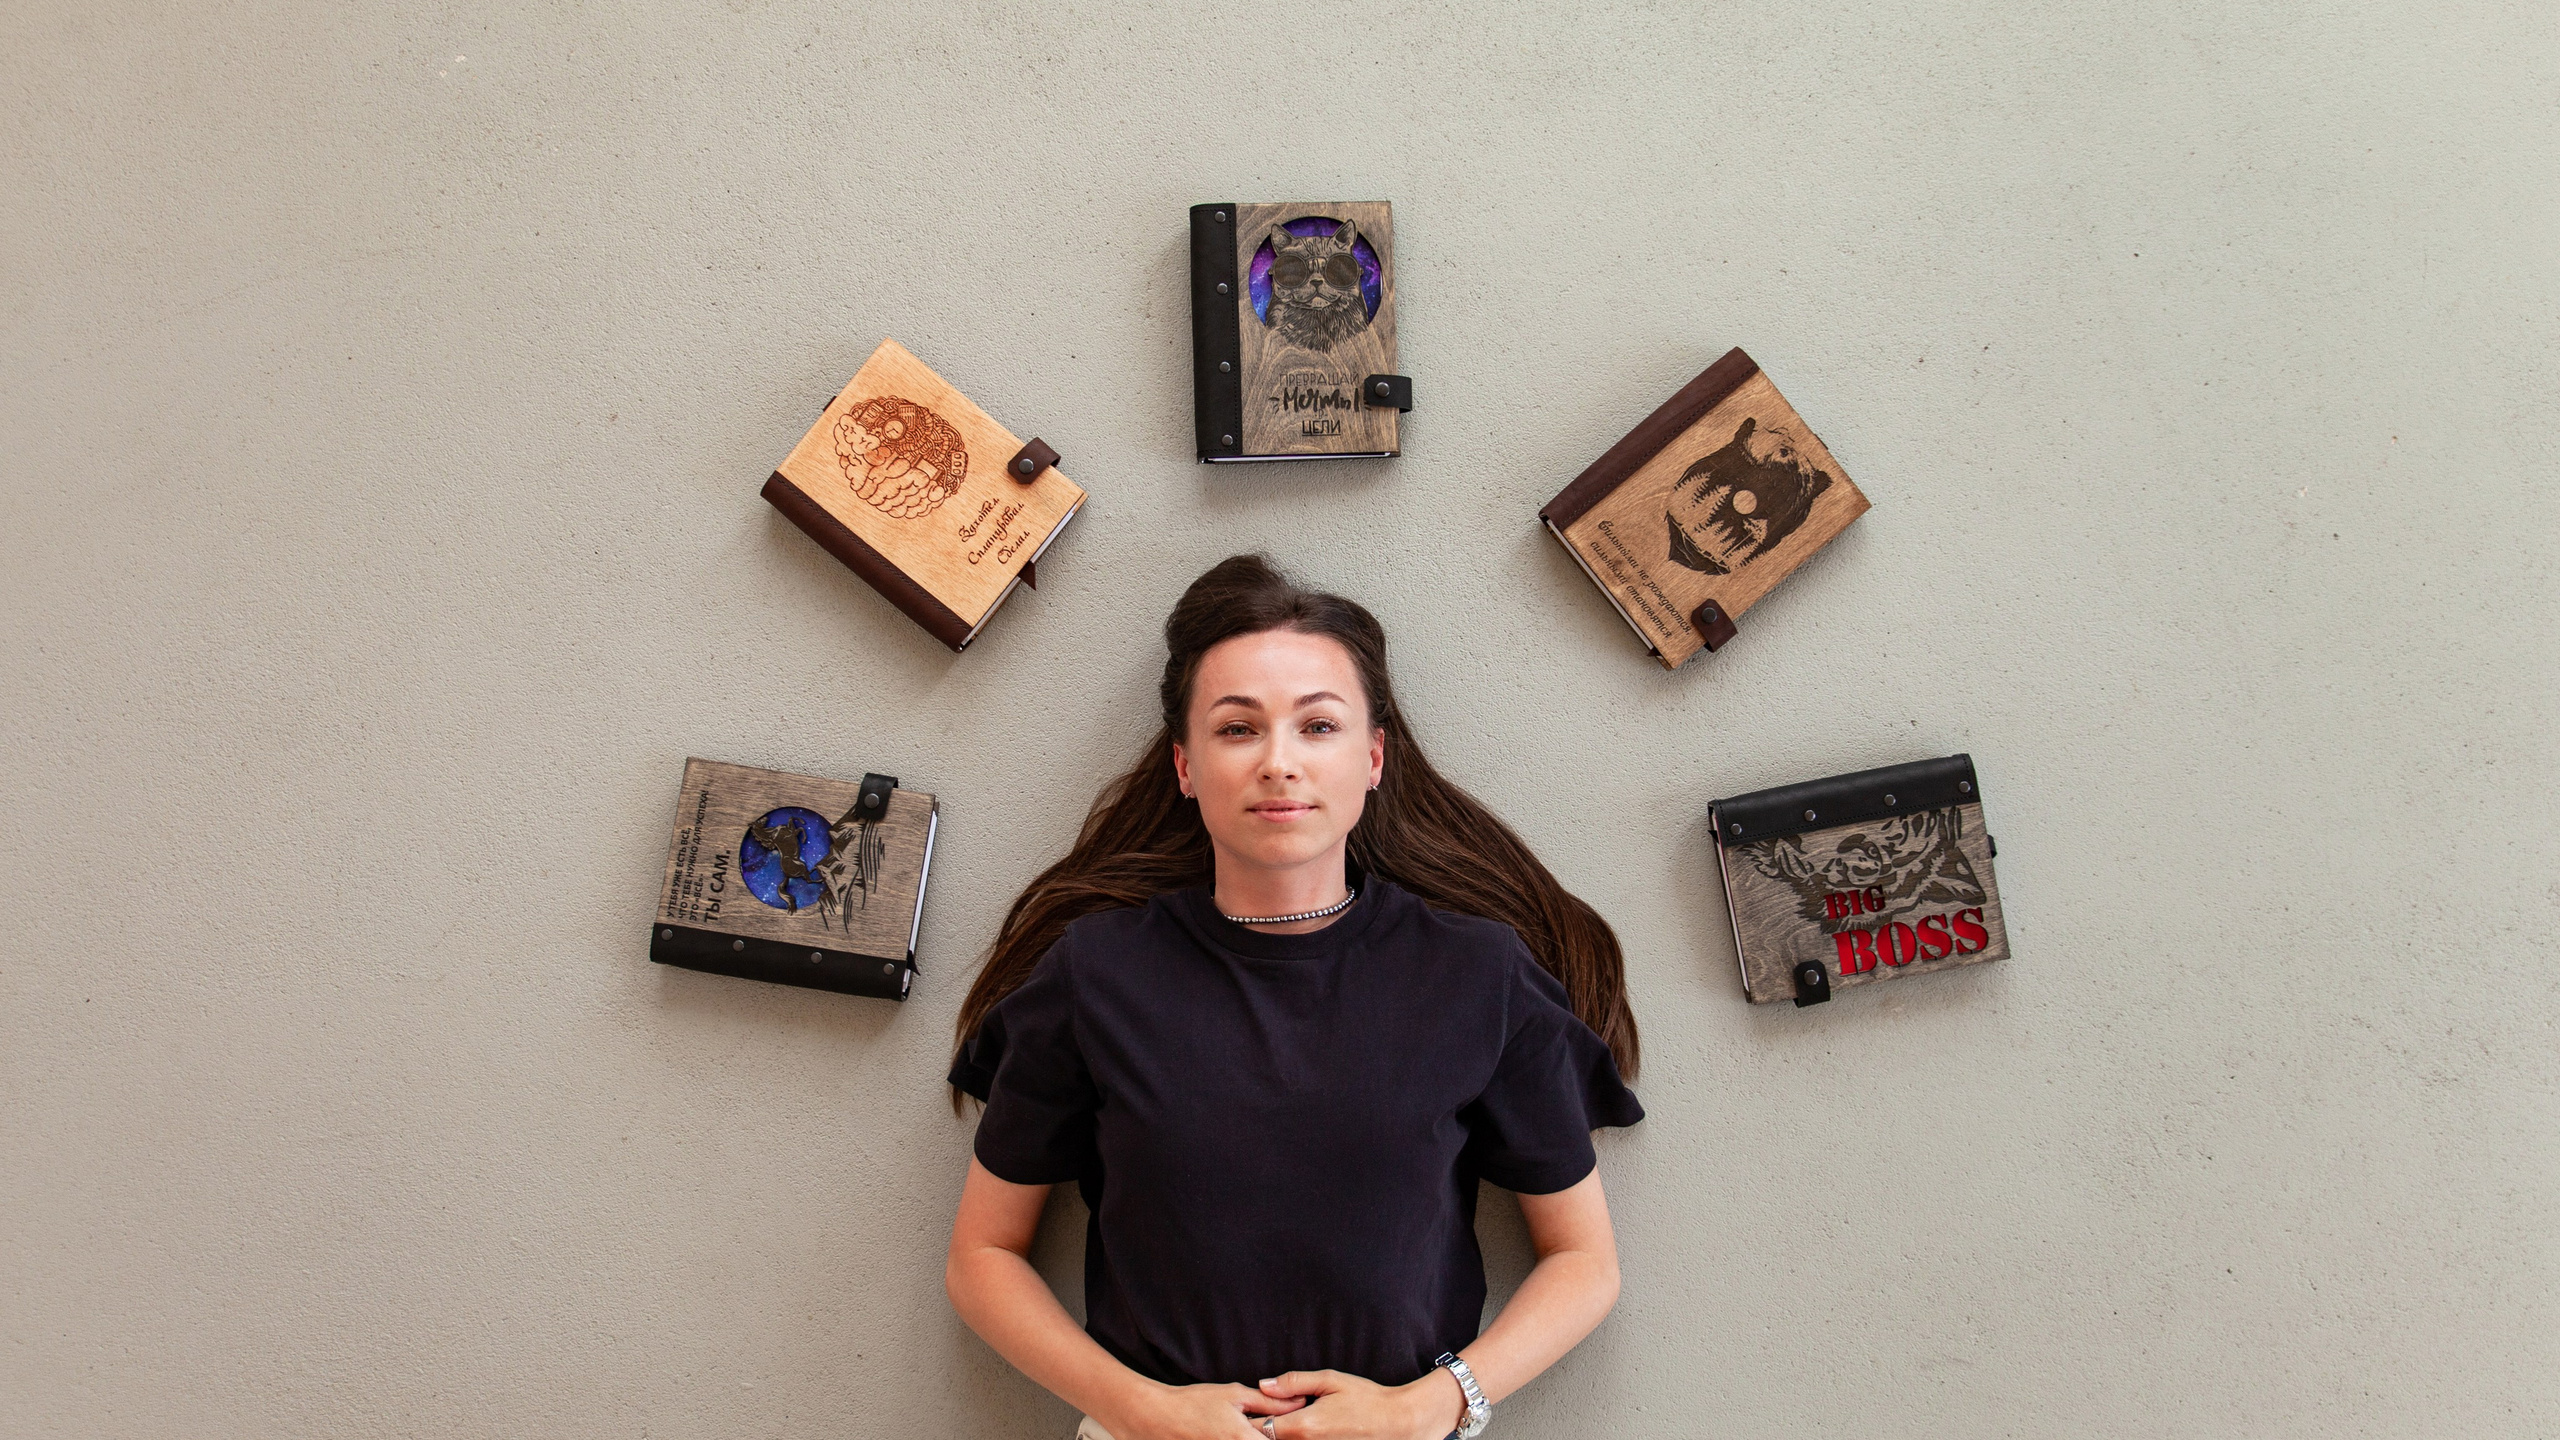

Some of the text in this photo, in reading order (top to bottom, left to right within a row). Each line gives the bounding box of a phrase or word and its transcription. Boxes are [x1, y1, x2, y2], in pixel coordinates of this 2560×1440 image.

[1279, 373, 1360, 386] ПРЕВРАЩАЙ
[1302, 419, 1341, 435] ЦЕЛИ
[1590, 541, 1673, 638] сильными становятся
[1598, 520, 1693, 635] Сильными не рождаются,
[677, 847, 687, 868] ЕСТЬ
[678, 790, 709, 919] ЧТО ТЕБЕ НУЖНО ДЛЯ УСПЕХА!
[673, 868, 682, 887] УЖЕ
[704, 850, 731, 922] ТЫ САМ.
[668, 888, 678, 910] ТЕБЯ
[689, 904, 699, 921] ЭТО
[1824, 884, 1886, 920] BIG
[1832, 907, 1989, 977] BOSS
